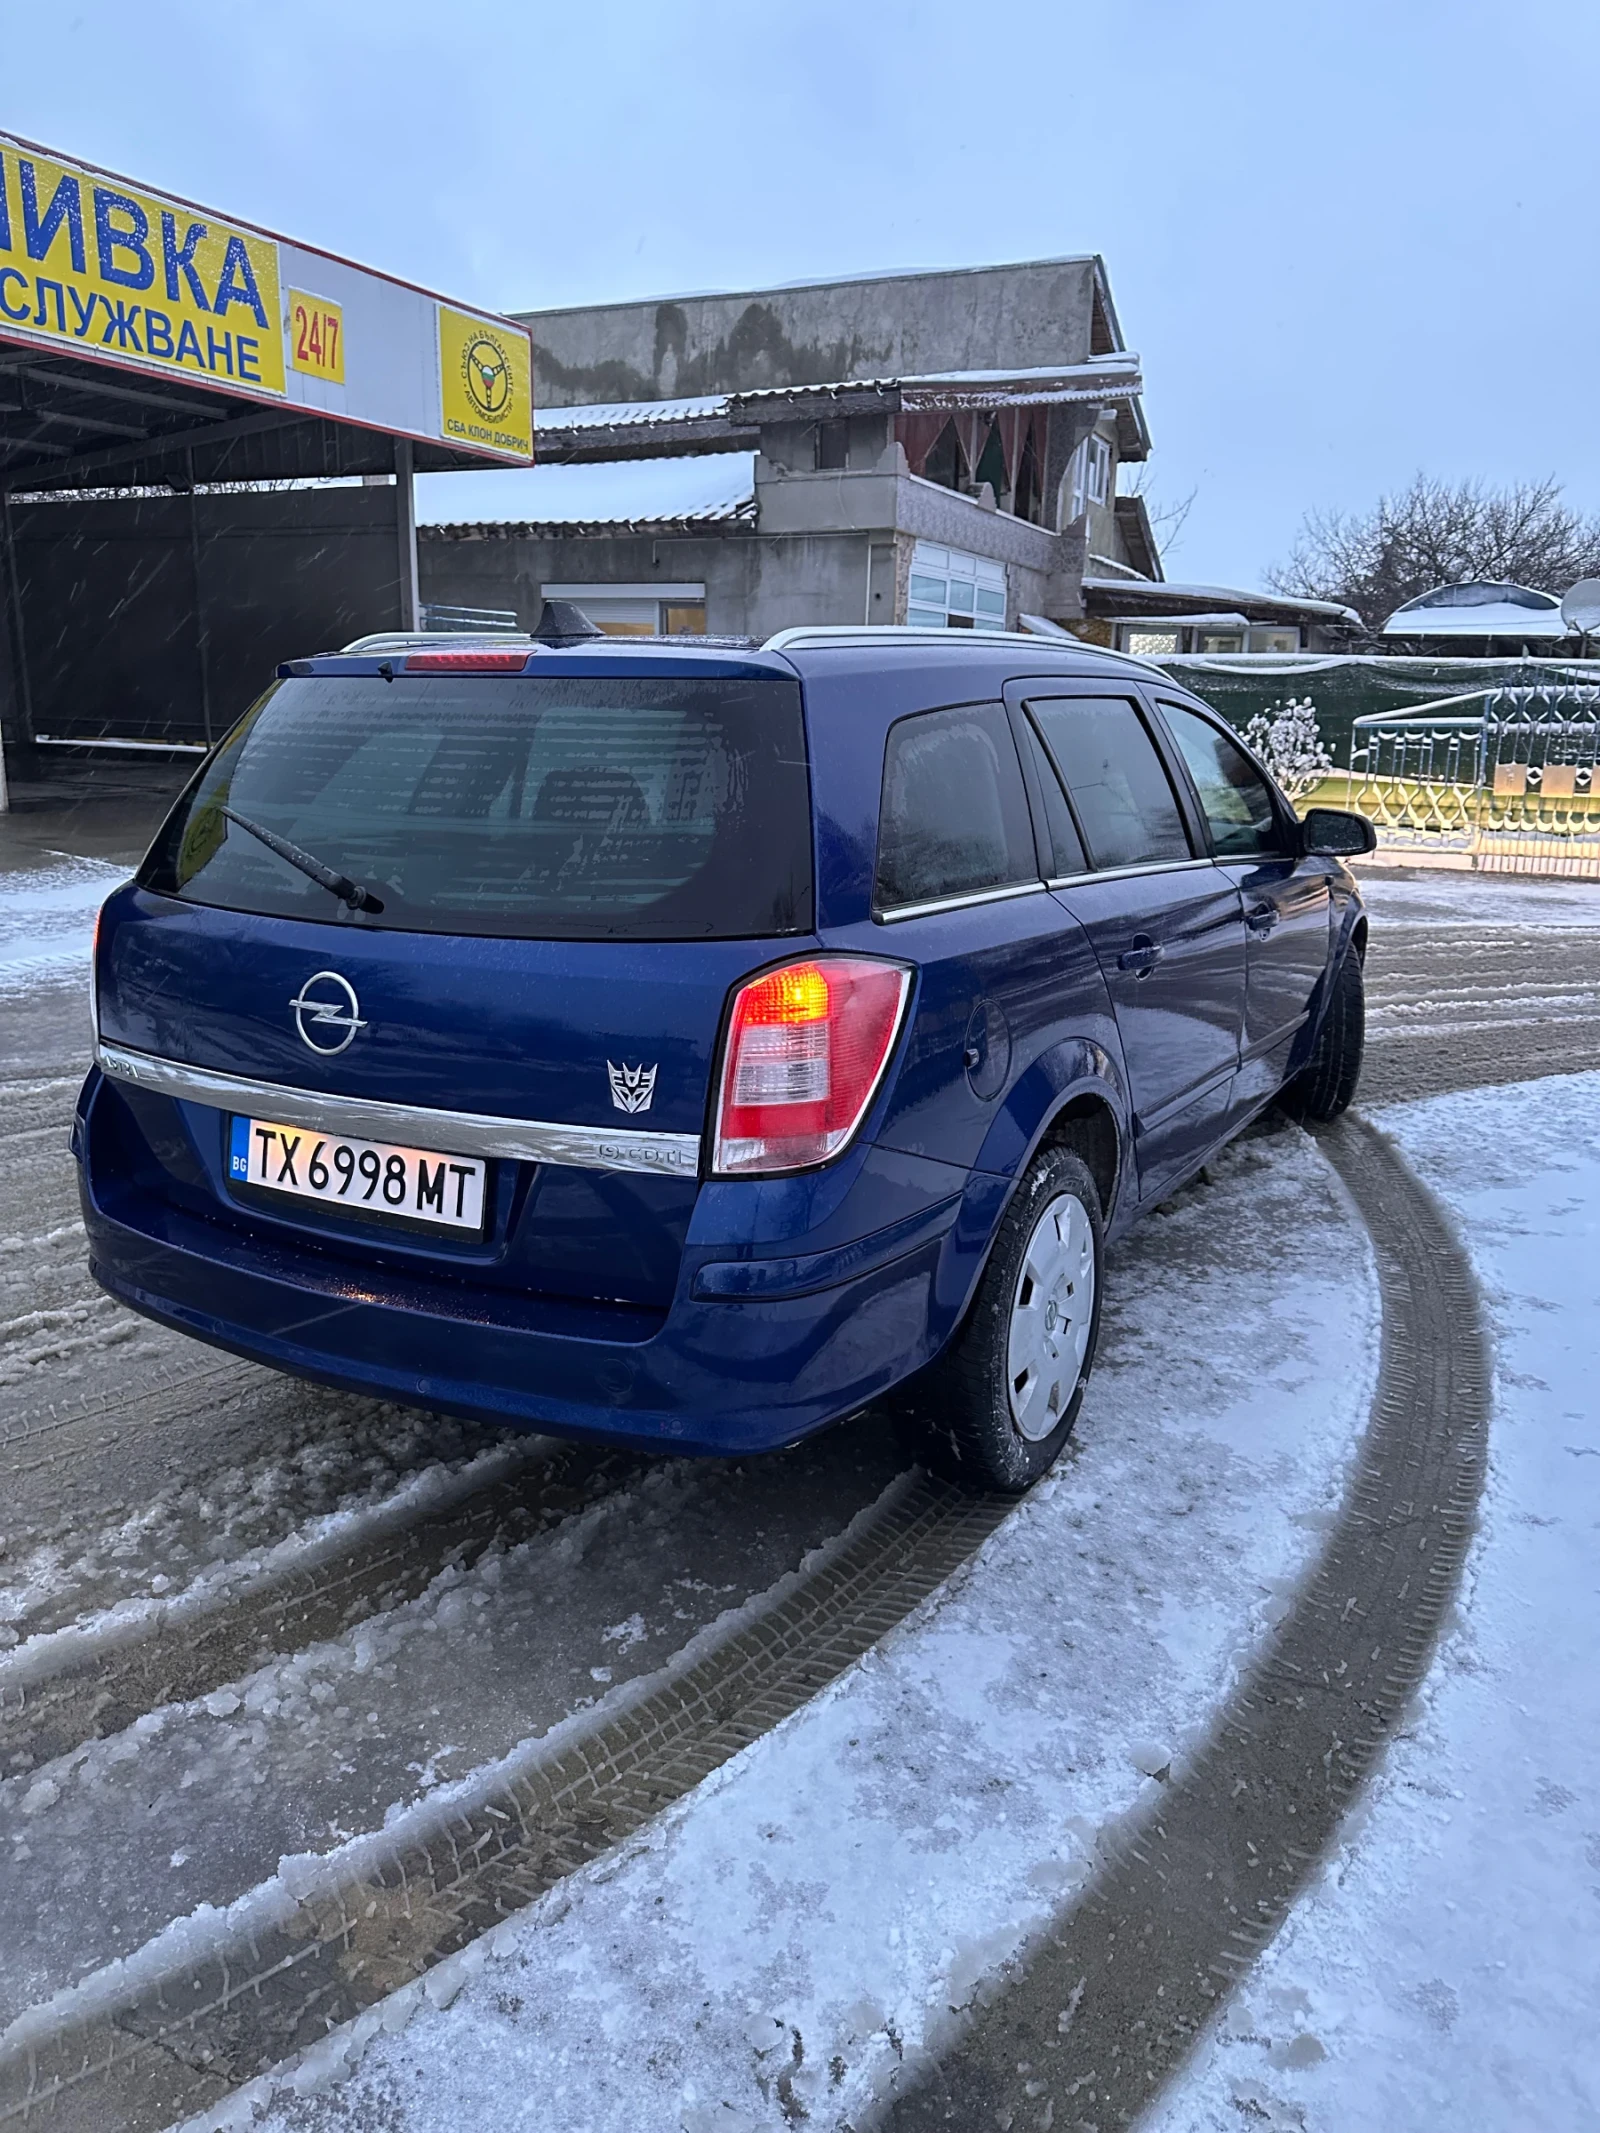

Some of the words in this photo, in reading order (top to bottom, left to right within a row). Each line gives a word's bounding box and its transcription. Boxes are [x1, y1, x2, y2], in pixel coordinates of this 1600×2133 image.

[0, 150, 269, 330] ИВКА
[0, 267, 262, 383] СЛУЖВАНЕ
[296, 305, 339, 369] 24/7
[461, 342, 471, 380] СЪЮЗ
[468, 332, 479, 343] НА
[447, 418, 466, 434] СБА
[468, 424, 493, 441] КЛОН
[494, 431, 529, 451] ДОБРИЧ
[233, 1156, 247, 1173] BG
[255, 1128, 301, 1186] TX
[308, 1140, 407, 1206] 6998
[416, 1159, 476, 1218] MT
